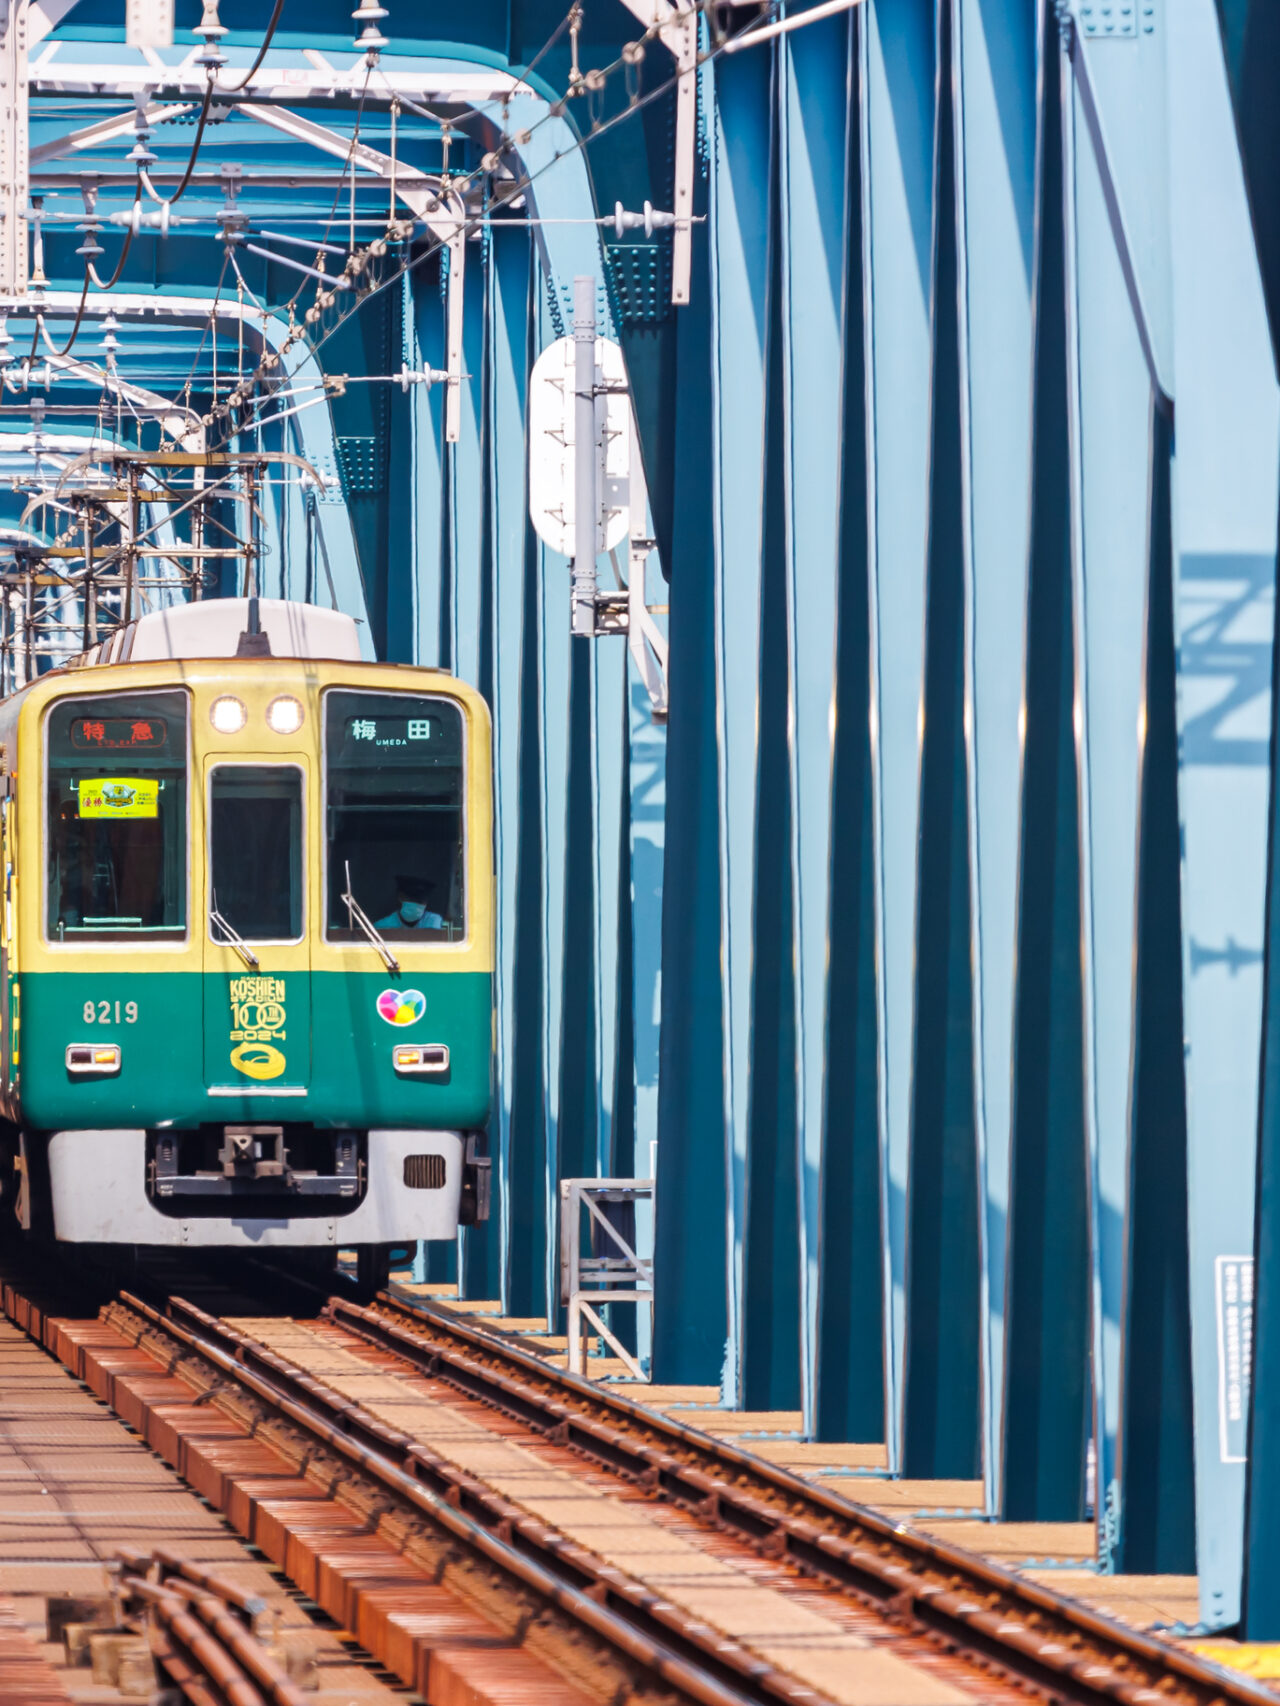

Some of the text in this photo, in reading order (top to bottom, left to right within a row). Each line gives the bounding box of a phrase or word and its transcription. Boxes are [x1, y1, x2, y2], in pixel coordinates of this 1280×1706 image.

[83, 722, 154, 741] 特急
[352, 719, 431, 740] 梅田
[230, 980, 286, 996] KOSHIEN
[83, 1000, 138, 1024] 8219
[230, 1030, 286, 1041] 2024
